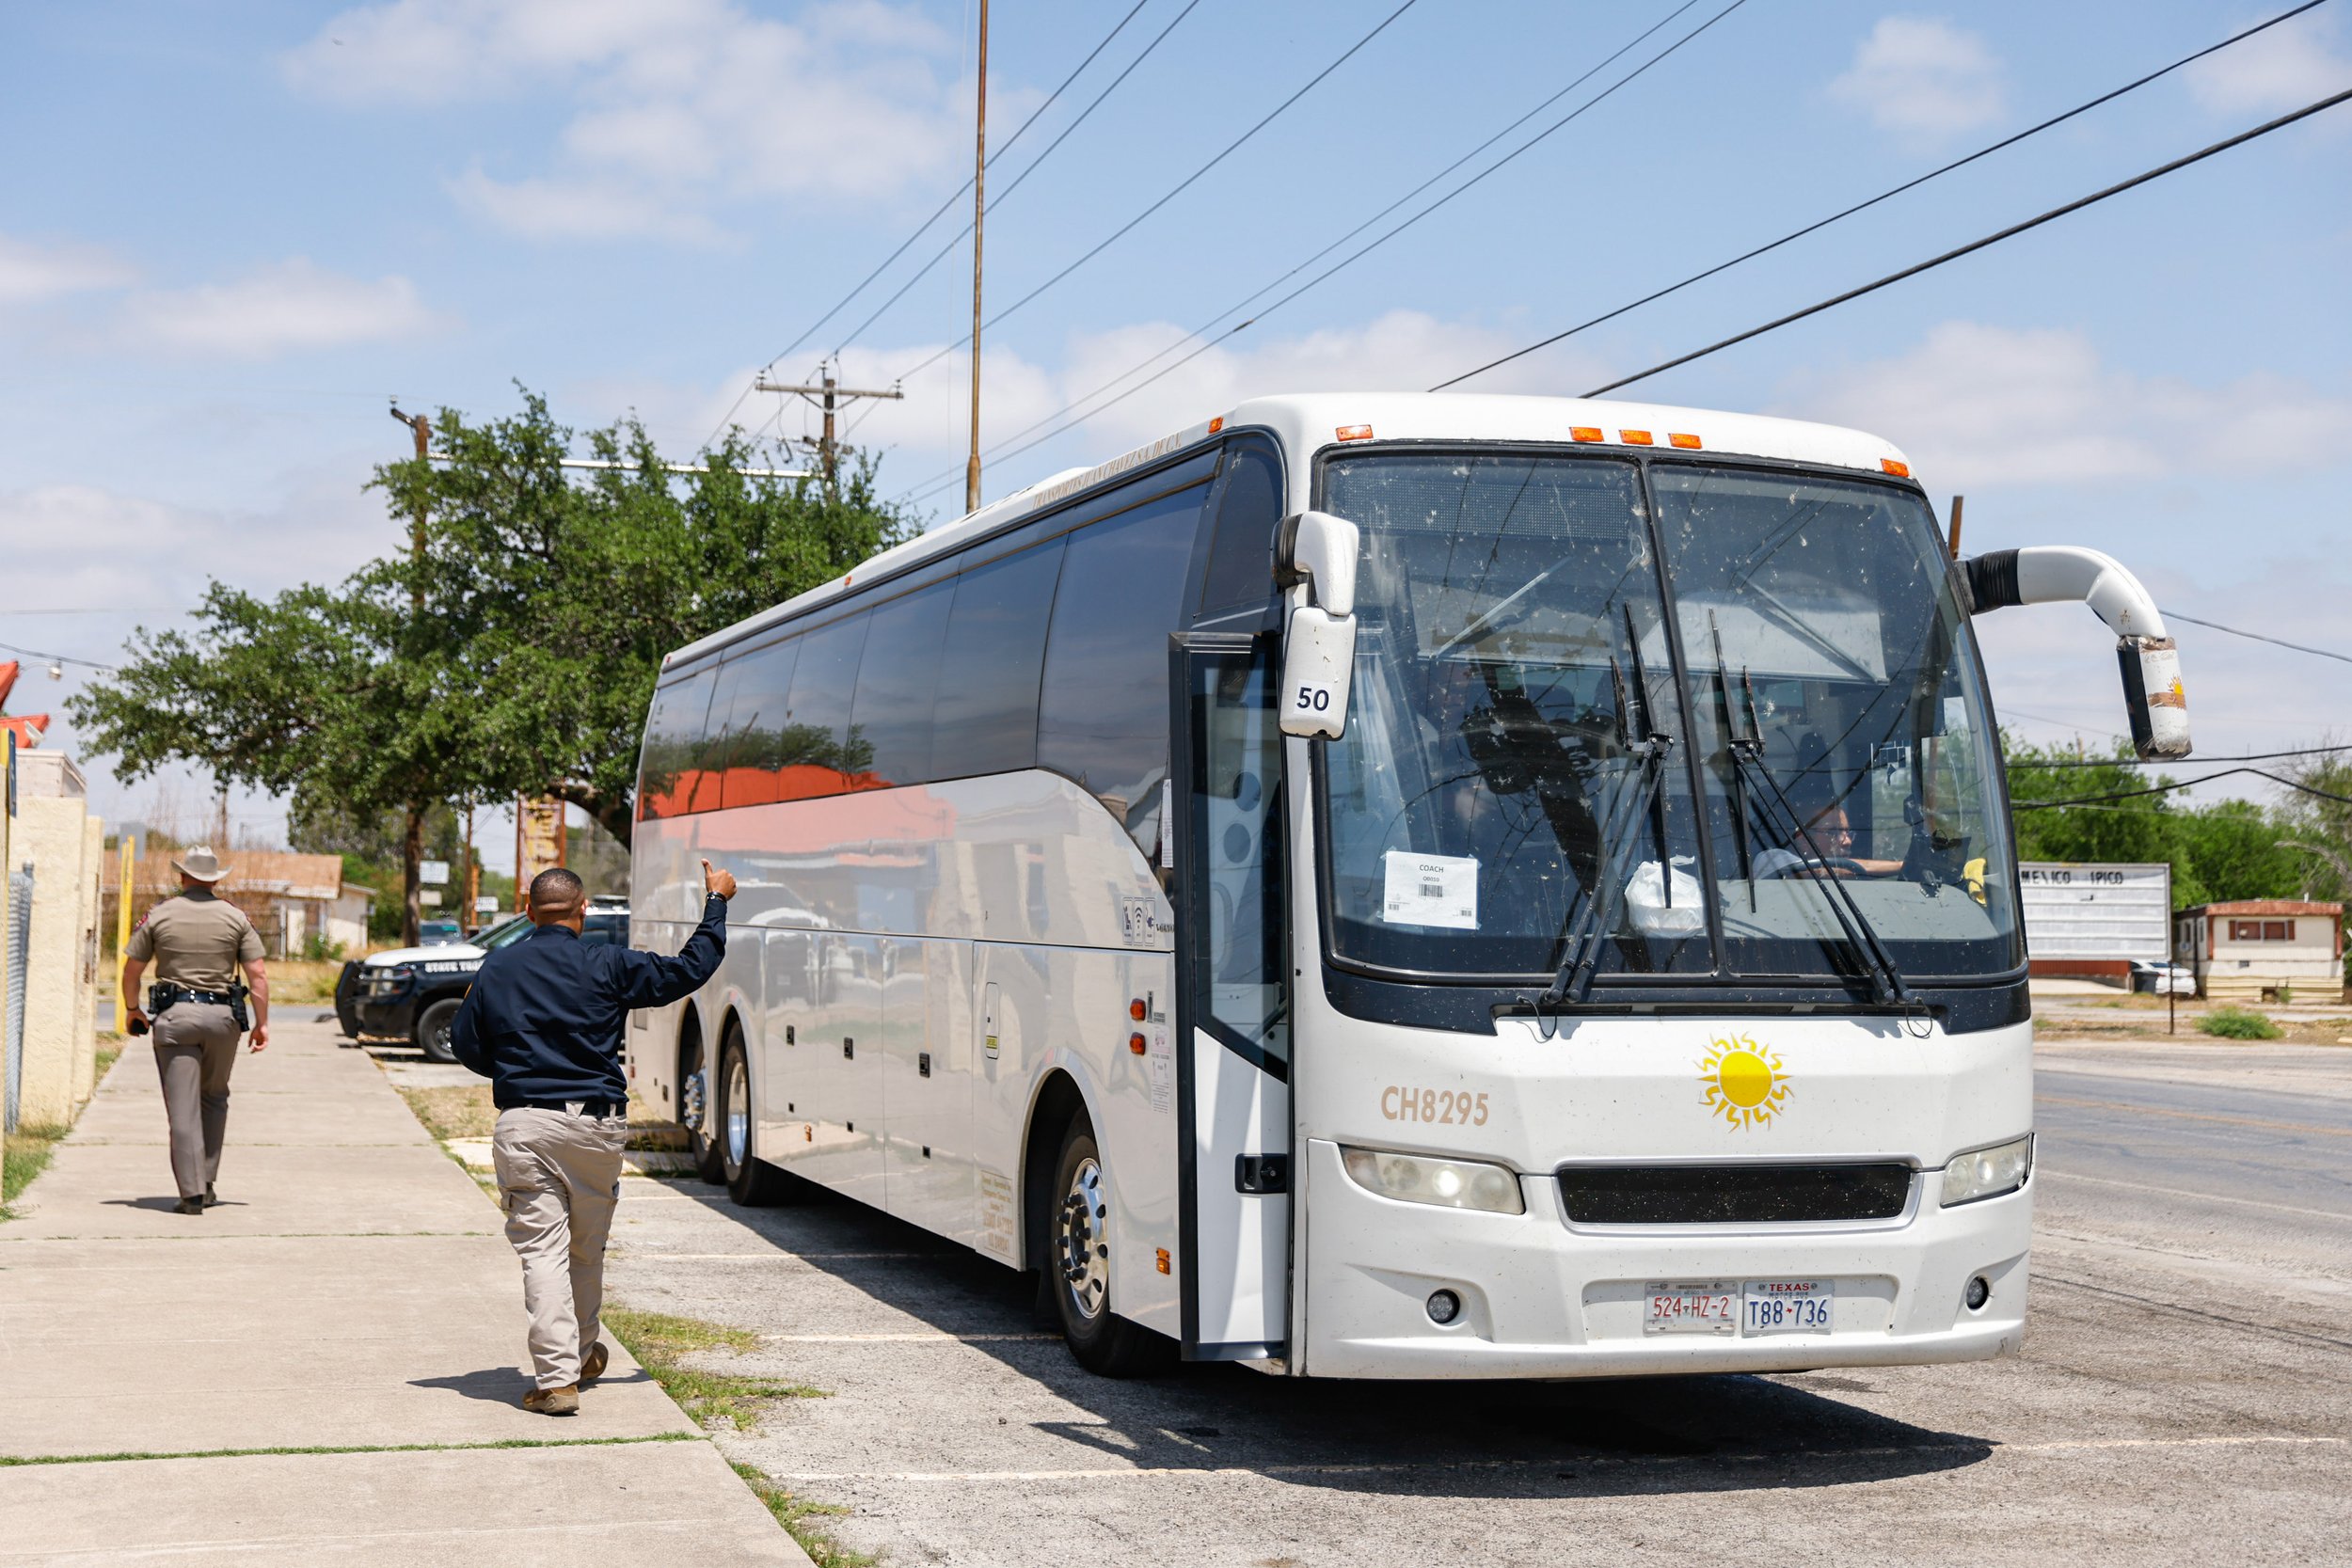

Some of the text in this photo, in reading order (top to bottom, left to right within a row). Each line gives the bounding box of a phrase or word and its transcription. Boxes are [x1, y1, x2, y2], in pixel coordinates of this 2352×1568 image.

[1295, 686, 1329, 712] 50
[1419, 864, 1444, 873] COACH
[424, 961, 459, 974] STATE
[1380, 1085, 1489, 1127] CH8295
[1769, 1282, 1810, 1292] TEXAS
[1653, 1295, 1729, 1318] 524-HZ-2
